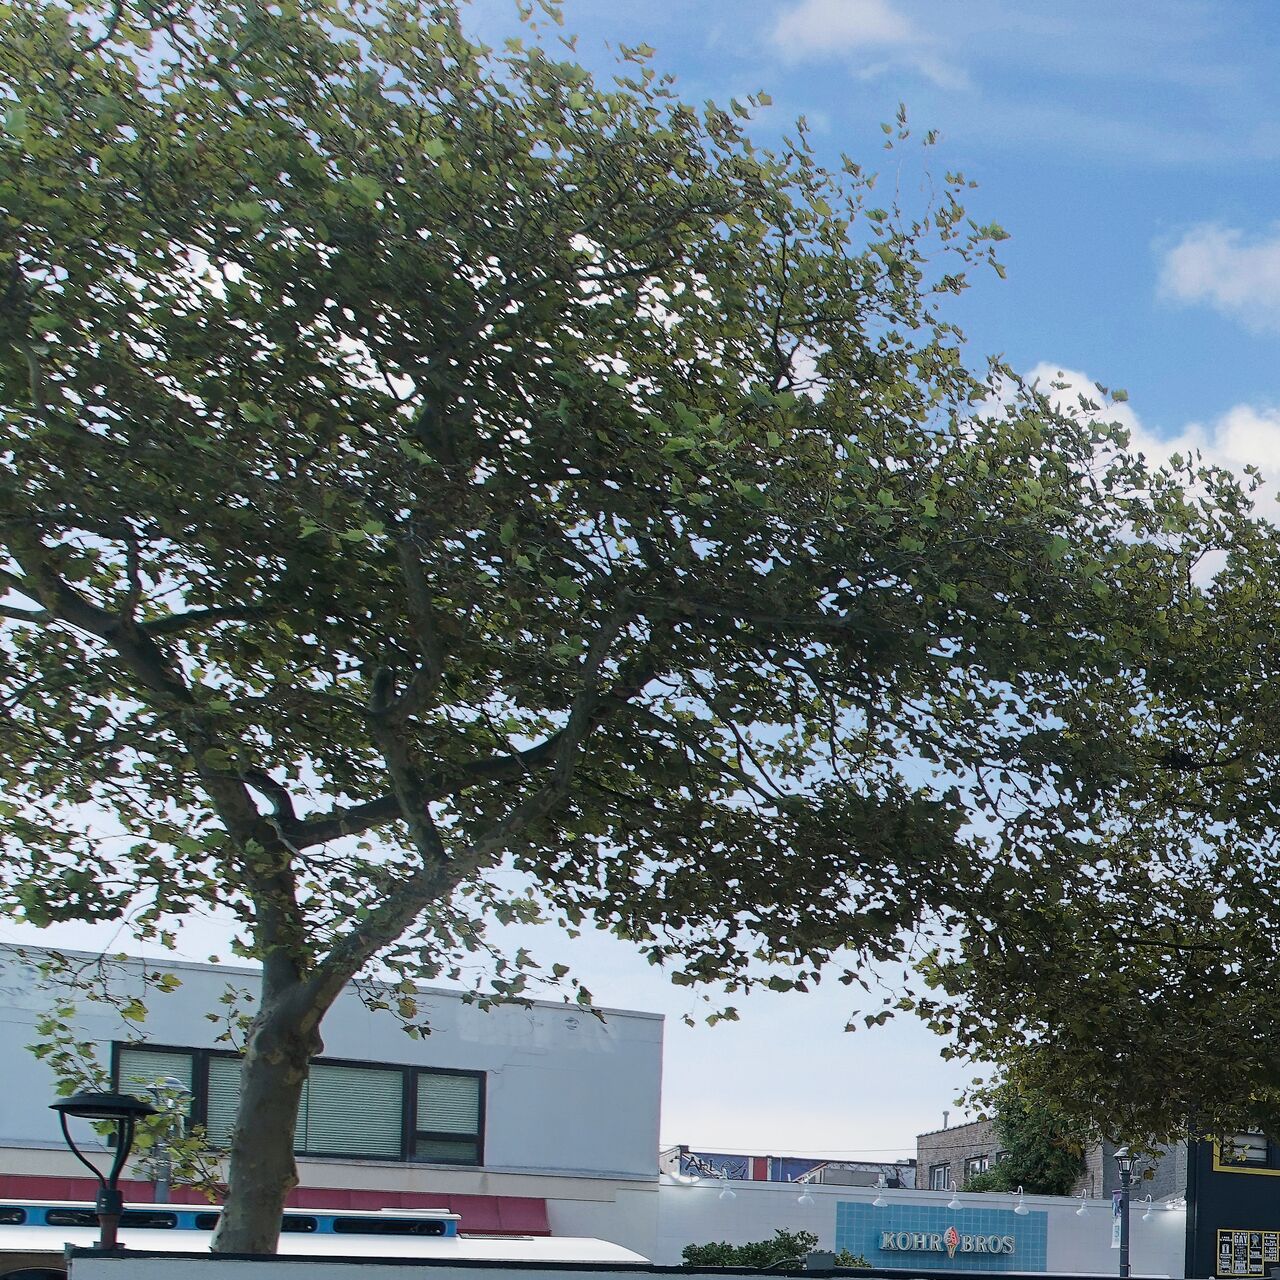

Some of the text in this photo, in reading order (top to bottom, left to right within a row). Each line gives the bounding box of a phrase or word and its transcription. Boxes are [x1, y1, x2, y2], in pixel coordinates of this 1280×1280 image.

[880, 1231, 1016, 1254] KOHR BROS
[1234, 1234, 1248, 1243] GAY
